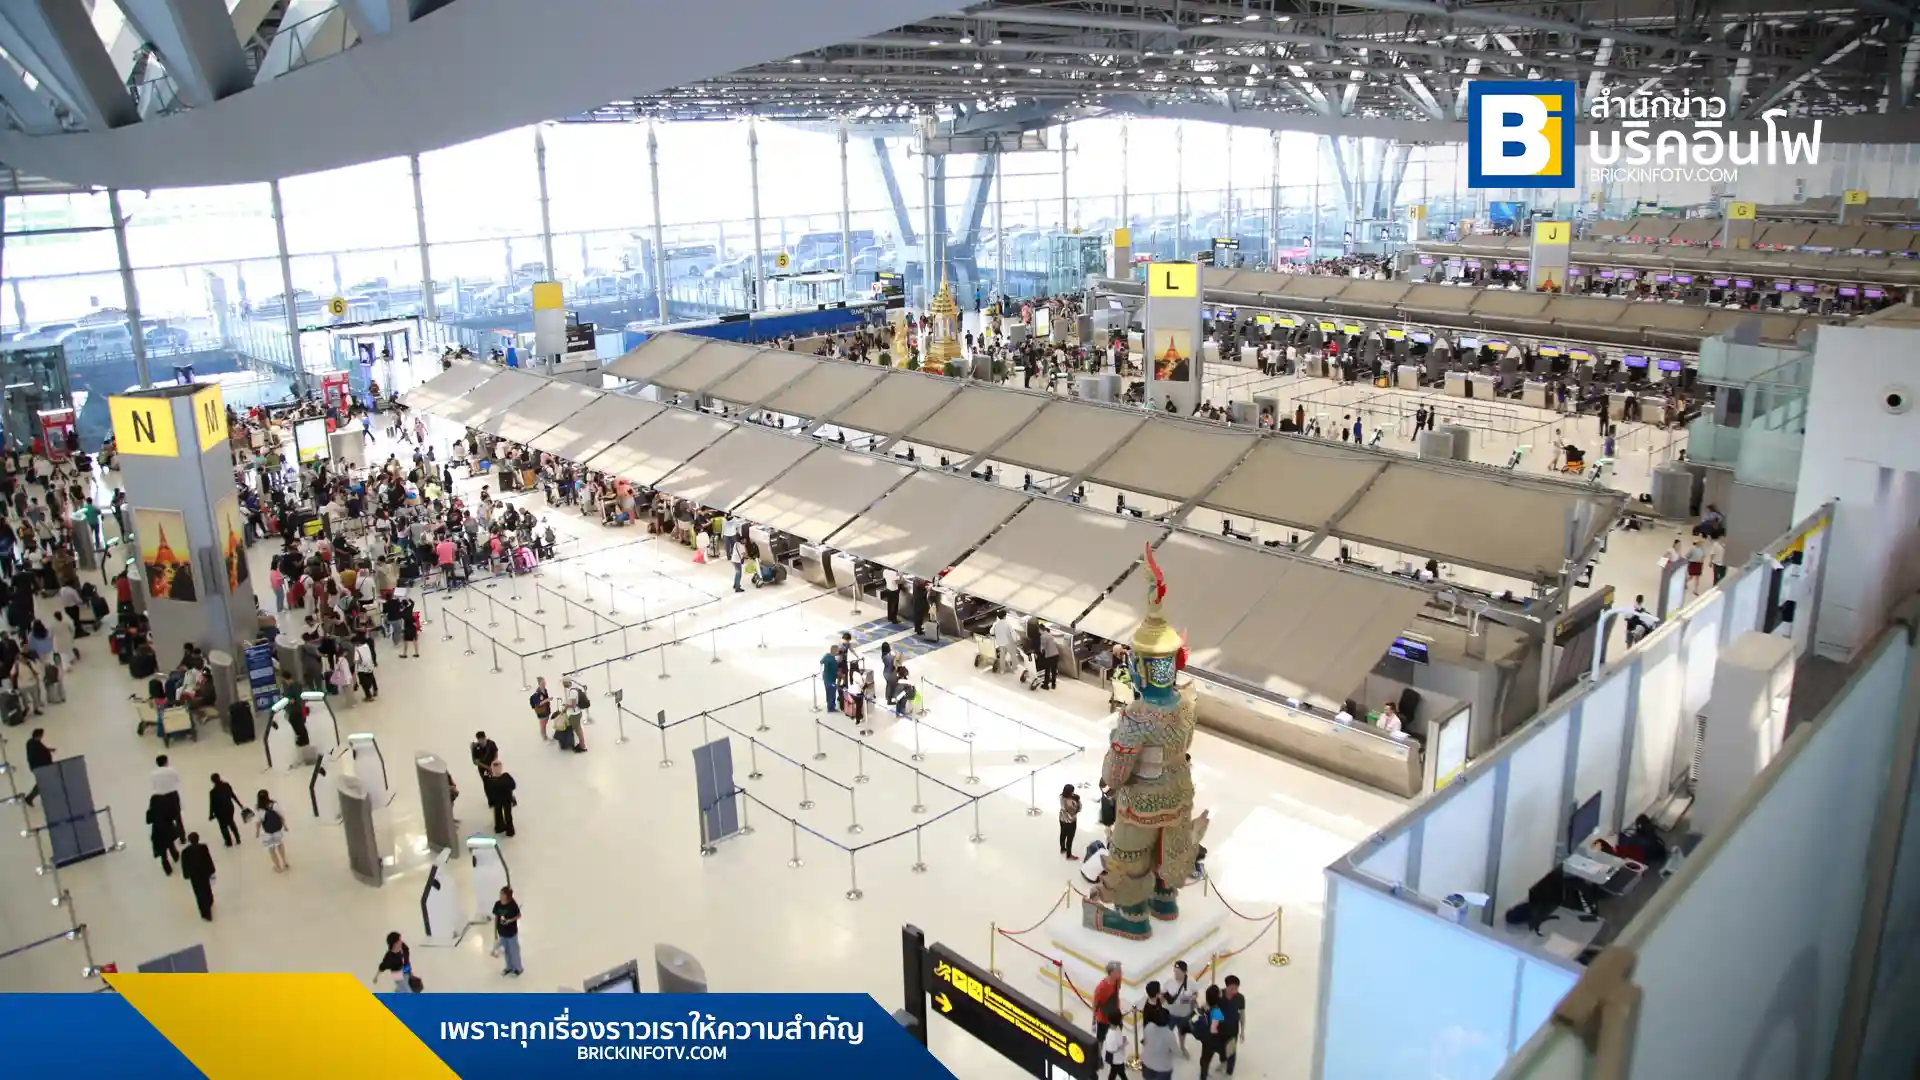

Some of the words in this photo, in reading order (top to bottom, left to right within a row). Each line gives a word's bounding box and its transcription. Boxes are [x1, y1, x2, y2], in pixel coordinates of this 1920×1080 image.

[1737, 205, 1747, 216] G
[1548, 227, 1557, 240] J
[780, 255, 787, 266] 5
[1166, 271, 1179, 290] L
[334, 300, 343, 314] 6
[204, 399, 219, 437] M
[131, 410, 156, 444] N
